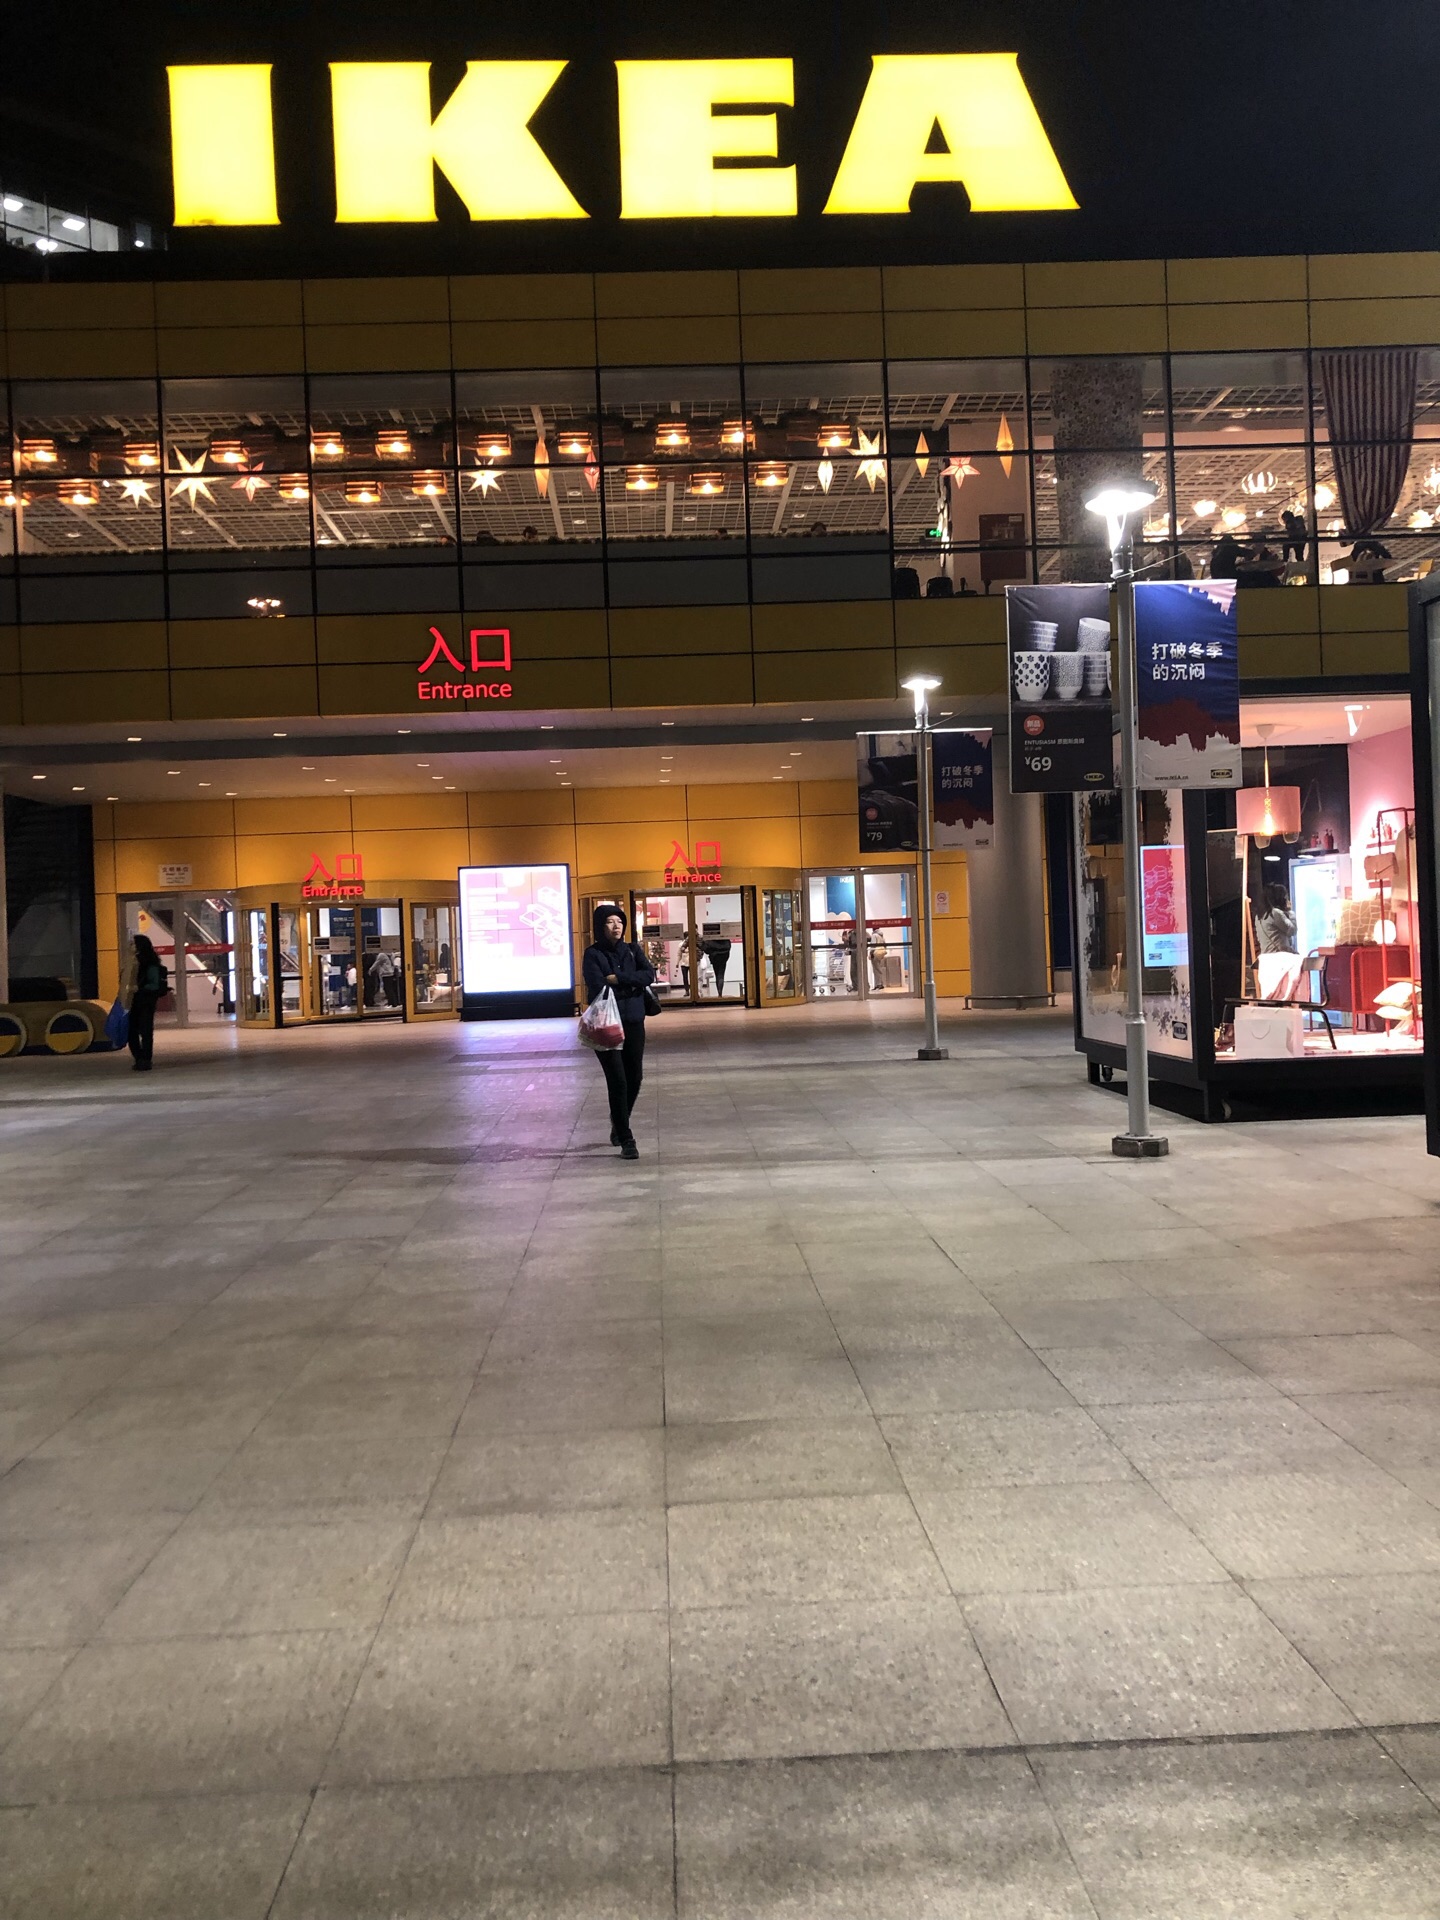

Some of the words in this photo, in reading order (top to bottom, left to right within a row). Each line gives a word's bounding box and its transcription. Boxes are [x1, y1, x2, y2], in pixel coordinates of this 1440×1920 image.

[166, 53, 1081, 227] IKEA
[418, 626, 512, 674] 入口
[1152, 641, 1223, 660] 打破冬季
[1152, 663, 1206, 681] 的沉闷
[417, 681, 512, 700] Entrance
[941, 765, 983, 777] 打破冬季
[1025, 757, 1052, 772] ¥69
[941, 778, 973, 789] 的沉闷
[866, 832, 883, 841] ¥79
[664, 840, 721, 869] 入口
[303, 852, 363, 881] 入口
[664, 872, 722, 884] Entrance
[302, 885, 363, 898] Entrance
